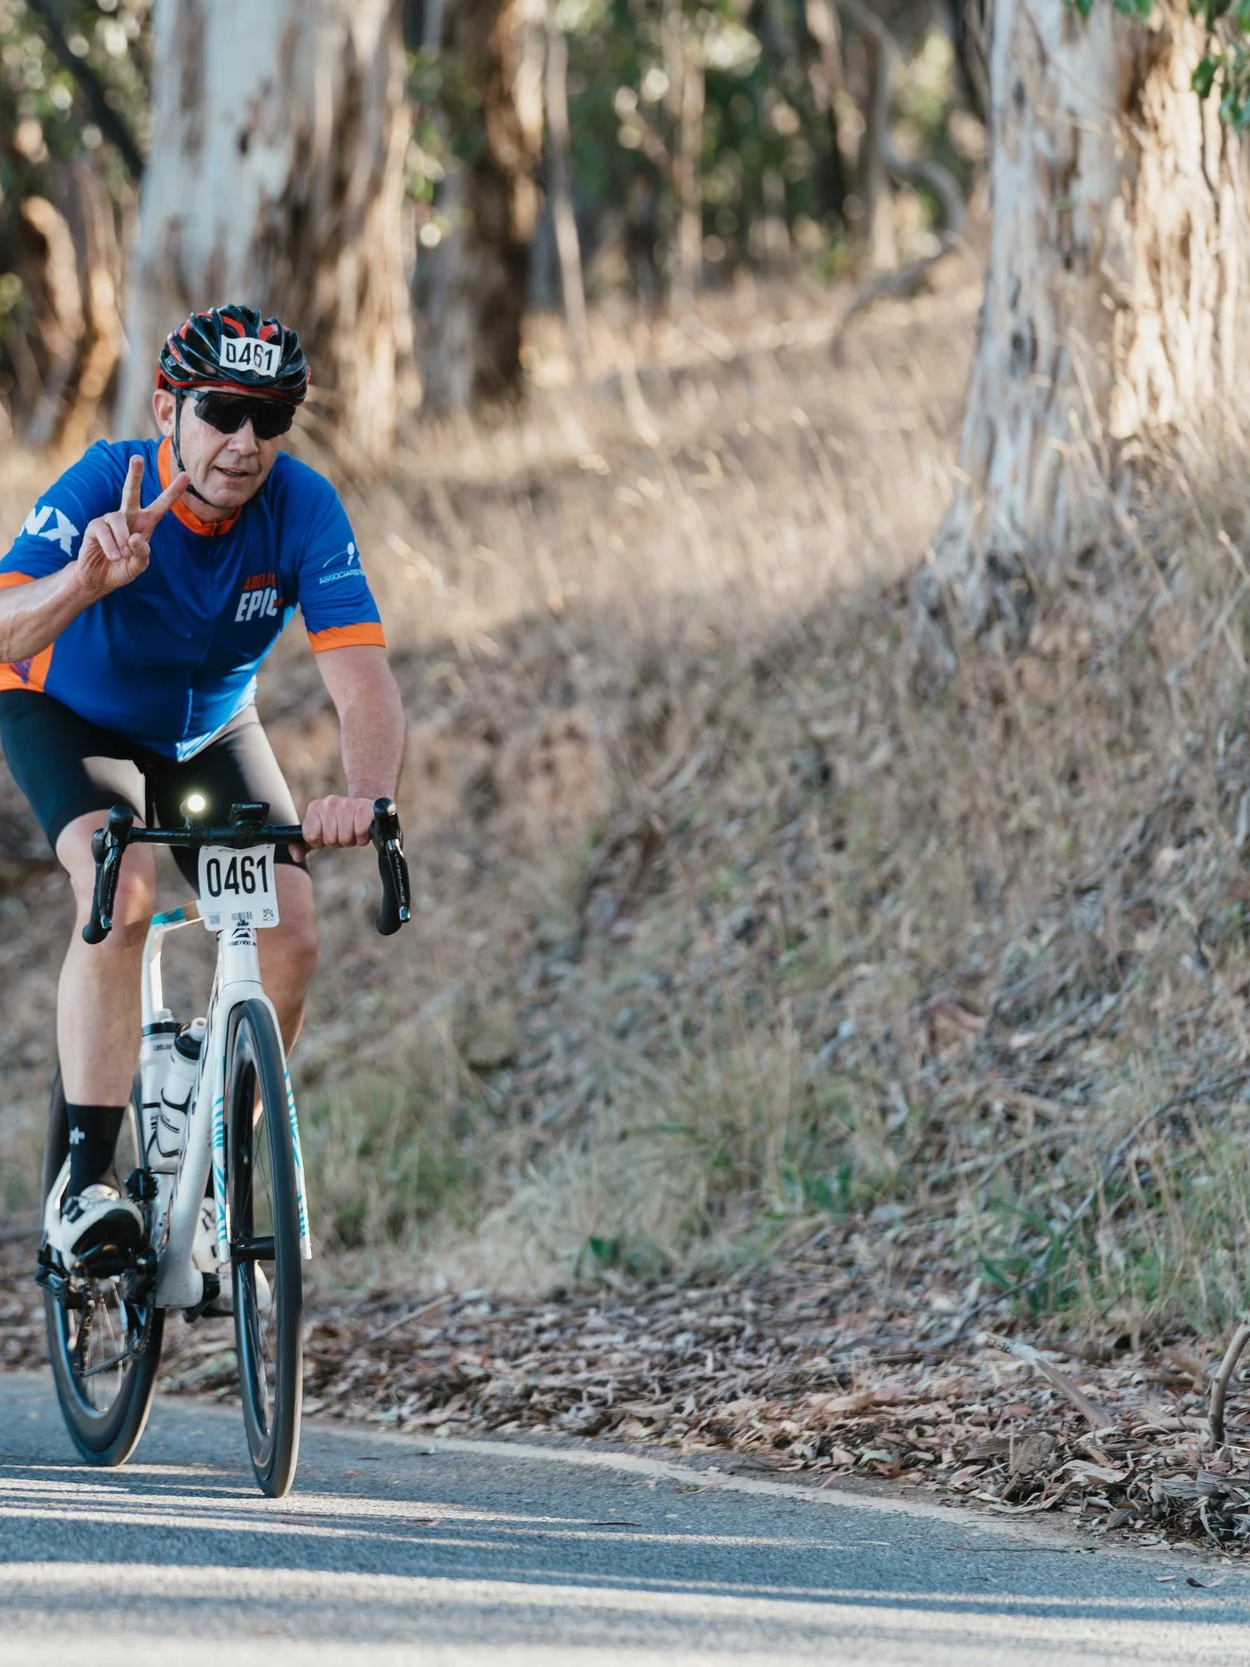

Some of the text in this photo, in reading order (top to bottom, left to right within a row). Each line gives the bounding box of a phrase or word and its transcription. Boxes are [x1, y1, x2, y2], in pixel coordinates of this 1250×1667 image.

[226, 342, 274, 371] 0461
[234, 587, 279, 623] EPIC
[206, 855, 269, 898] 0461
